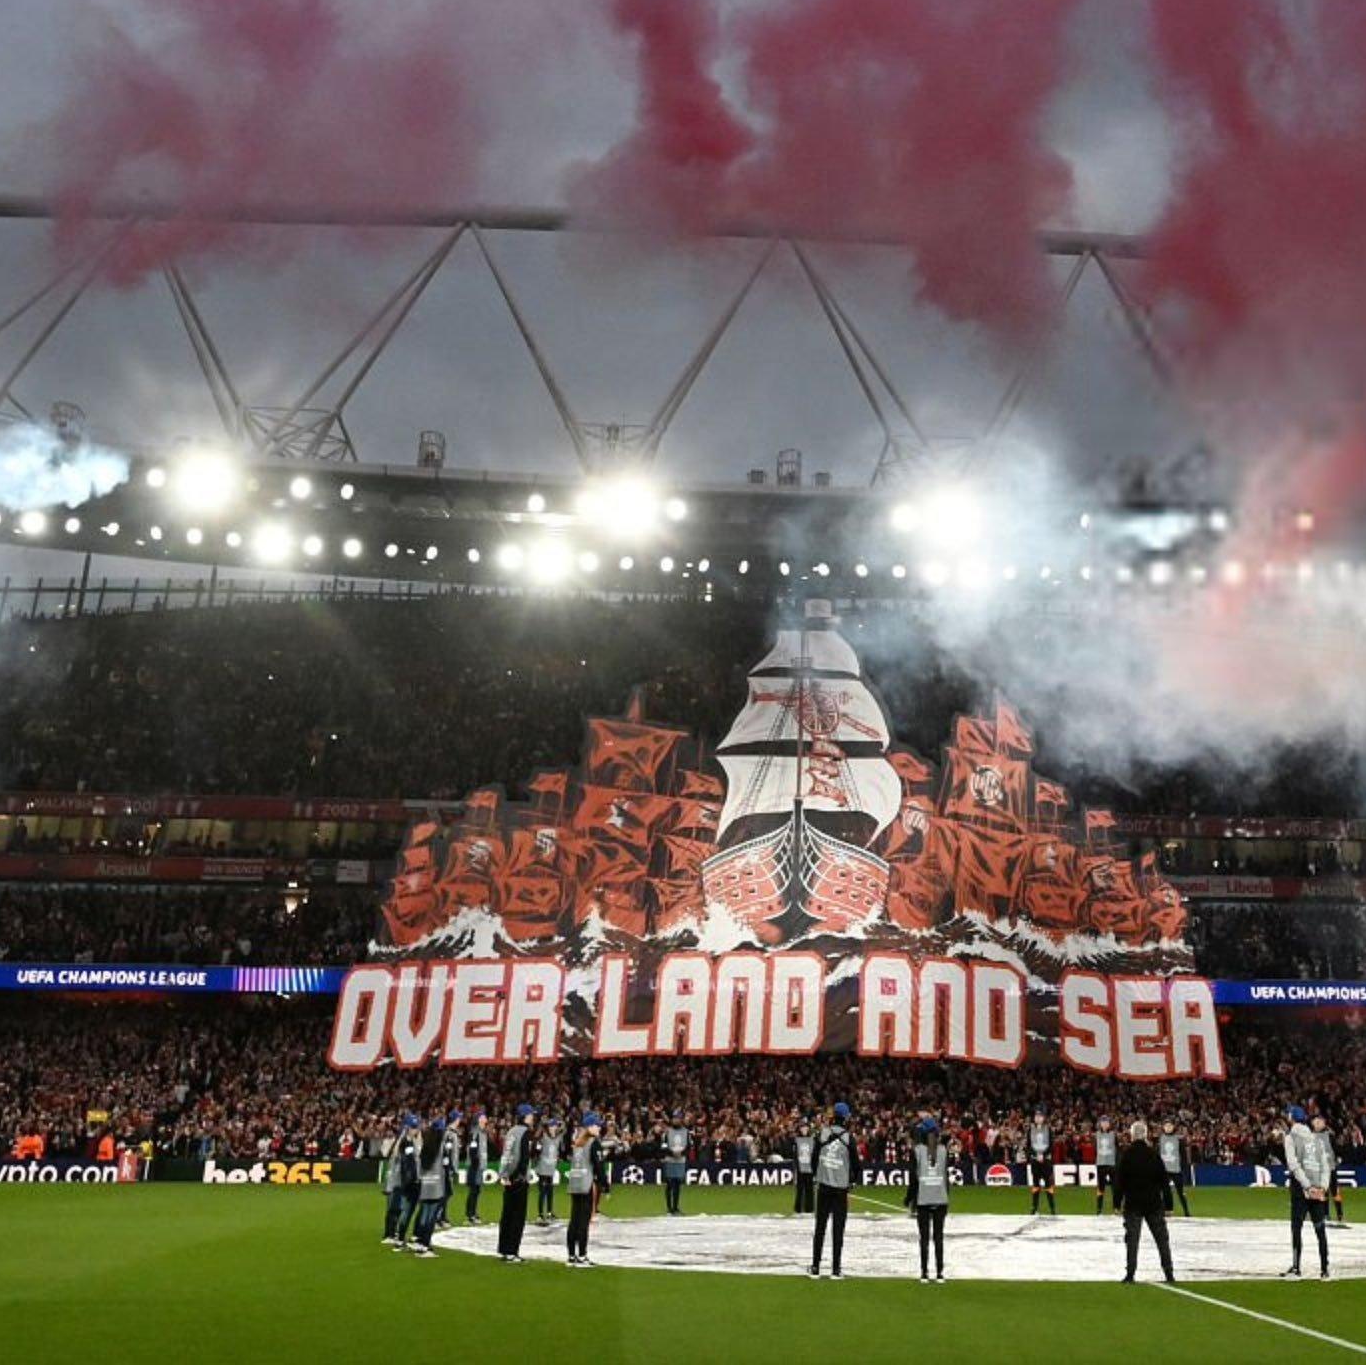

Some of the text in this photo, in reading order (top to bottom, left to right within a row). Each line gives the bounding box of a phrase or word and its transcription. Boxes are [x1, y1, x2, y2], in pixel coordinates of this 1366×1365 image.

[17, 970, 208, 986] UEFA CHAMPIONS LEAGUE
[1250, 986, 1286, 999] UEFA
[329, 950, 1227, 1080] OVER LAND AND SEA
[203, 1159, 333, 1183] bet365
